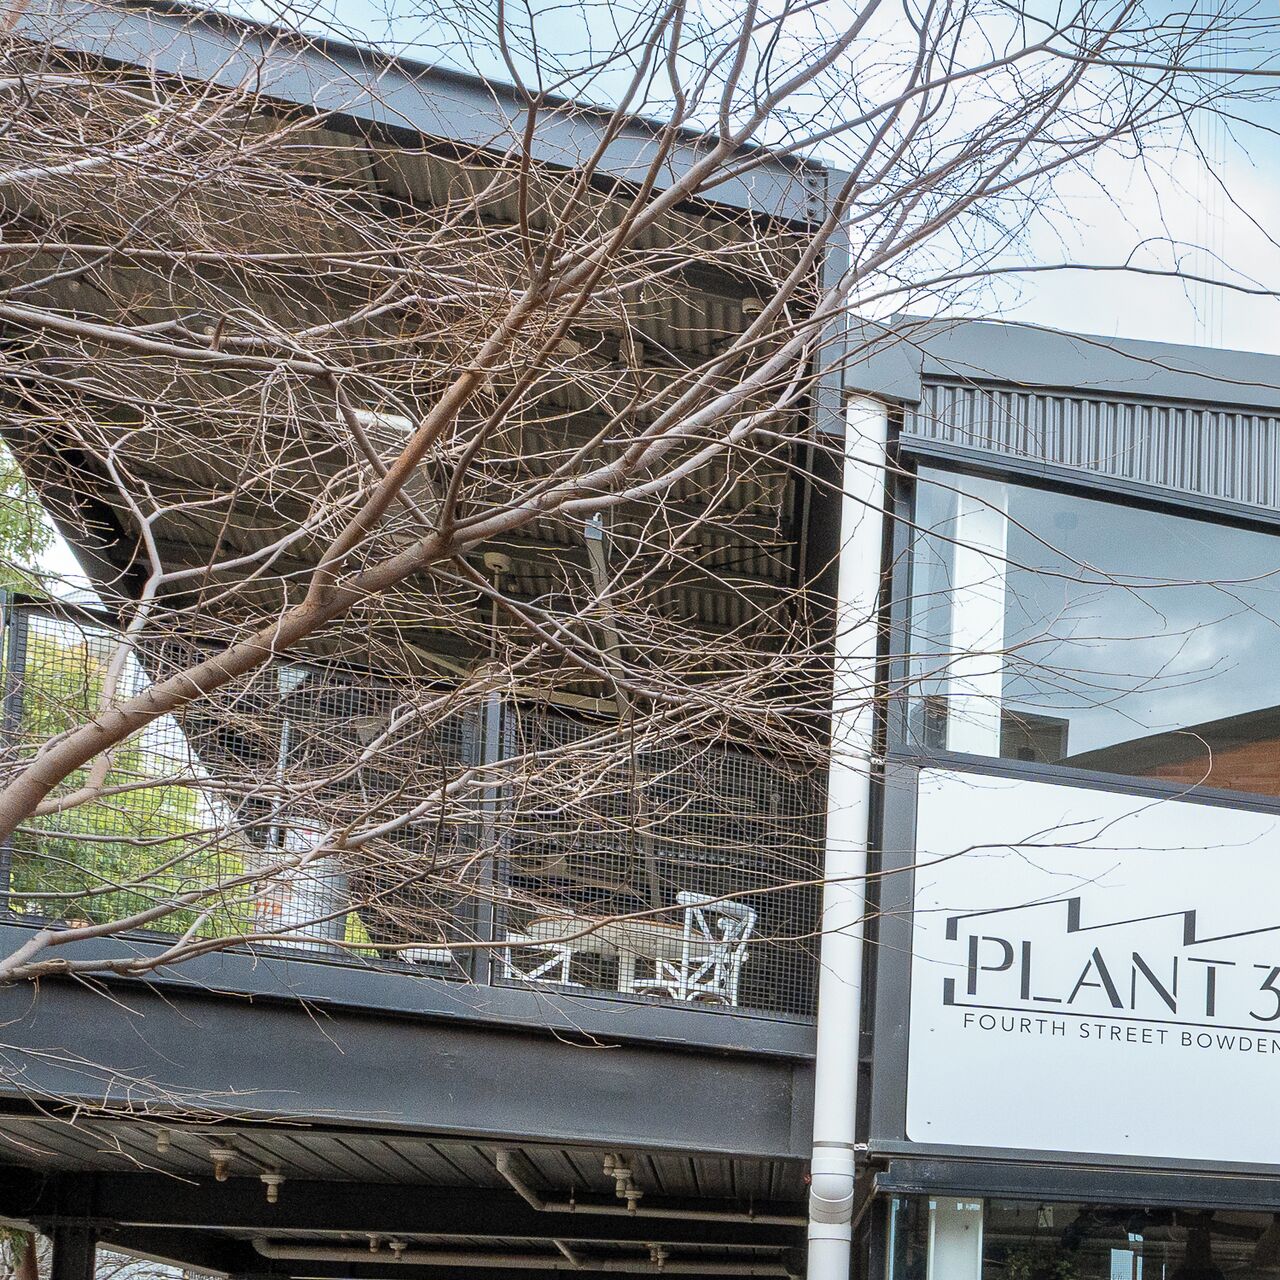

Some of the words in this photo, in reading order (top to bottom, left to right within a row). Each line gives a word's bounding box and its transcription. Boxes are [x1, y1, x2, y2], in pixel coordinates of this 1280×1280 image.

[966, 934, 1236, 1017] PLANT
[963, 1013, 1066, 1036] FOURTH
[1079, 1022, 1169, 1045] STREET
